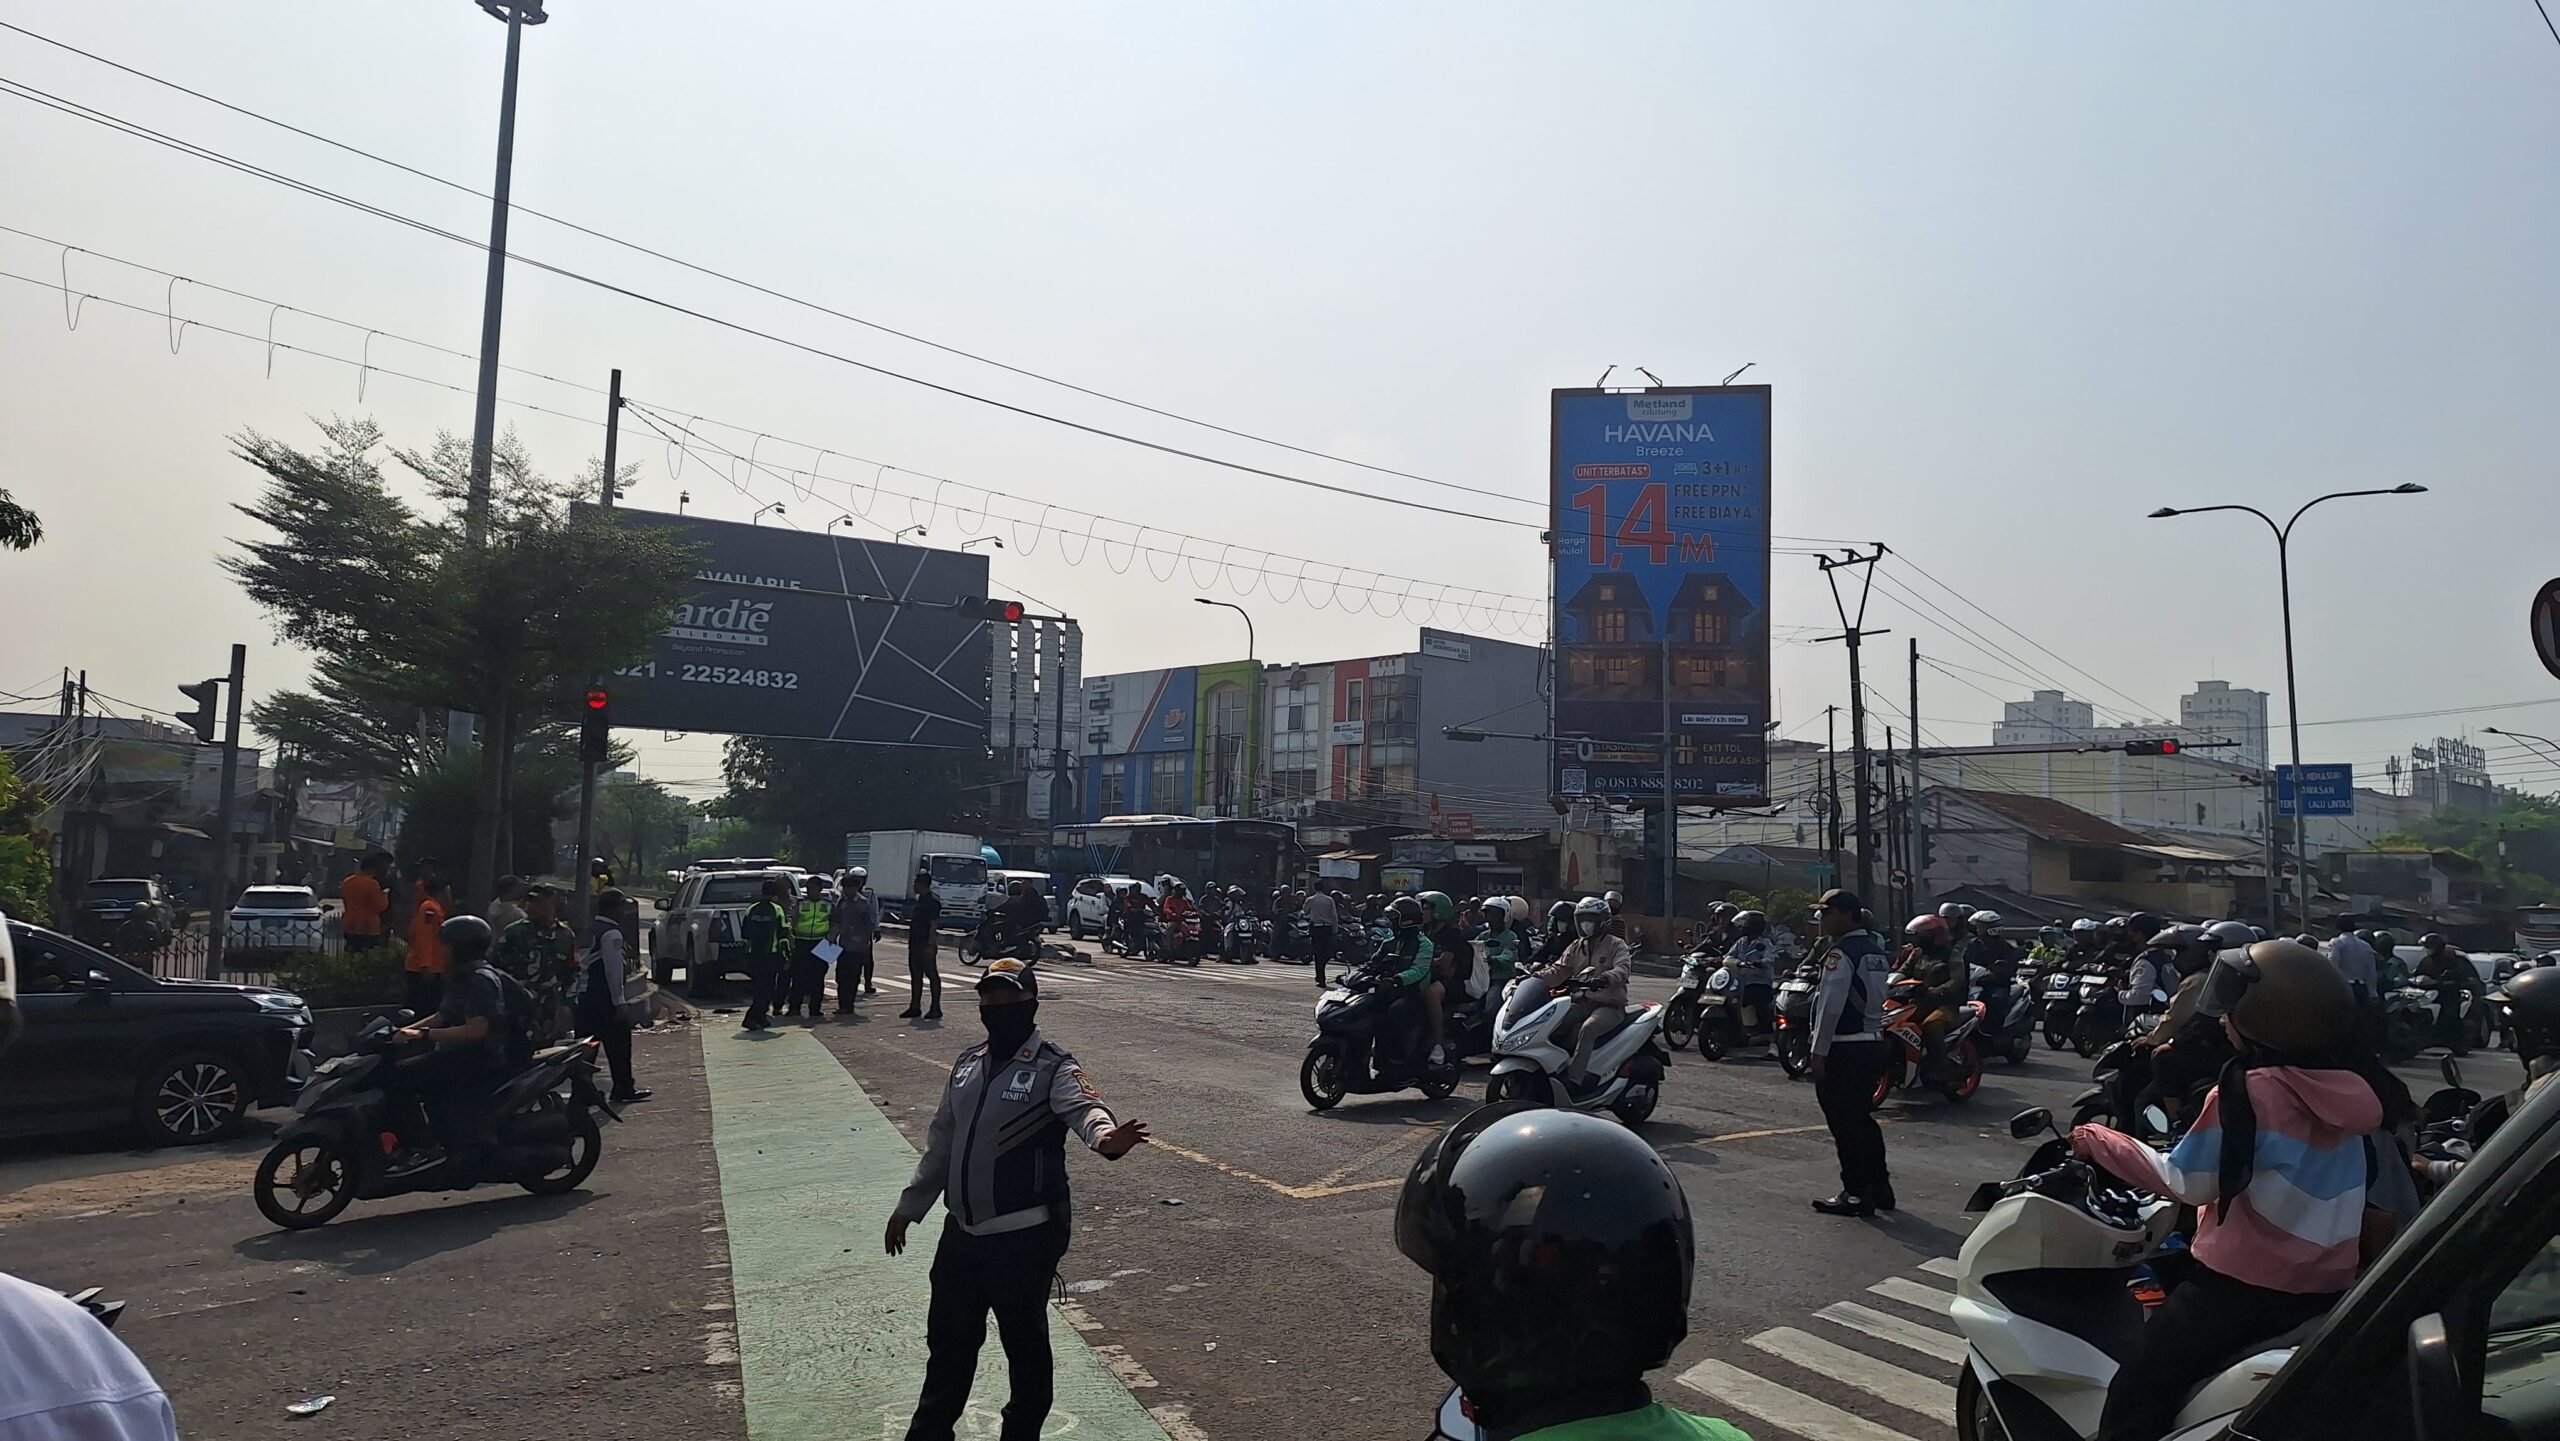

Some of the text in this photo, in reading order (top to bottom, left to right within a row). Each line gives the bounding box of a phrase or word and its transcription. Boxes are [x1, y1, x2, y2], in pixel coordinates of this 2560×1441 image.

[1633, 399, 1686, 409] Metland
[1642, 408, 1677, 417] cibitung
[1604, 423, 1714, 443] HAVANA
[1636, 446, 1684, 457] Breeze
[1577, 467, 1597, 477] UNIT
[1674, 484, 1707, 497] FREE
[1674, 506, 1752, 518] FREE BIAYA
[1572, 482, 1676, 571] 1,4
[1558, 537, 1586, 546] Harga
[1558, 547, 1583, 555] Mulai
[676, 630, 765, 643] LLBOARD
[672, 643, 746, 657] Beyond Promotion
[681, 663, 799, 690] 22524832
[1702, 744, 1743, 753] EXIT TOL
[1703, 756, 1738, 765] TELAGA
[1608, 776, 1638, 789] 0813
[1641, 777, 1665, 790] 888
[1674, 778, 1704, 790] 8202
[2301, 785, 2335, 795] AWASAN
[1902, 1029, 1921, 1047] REP
